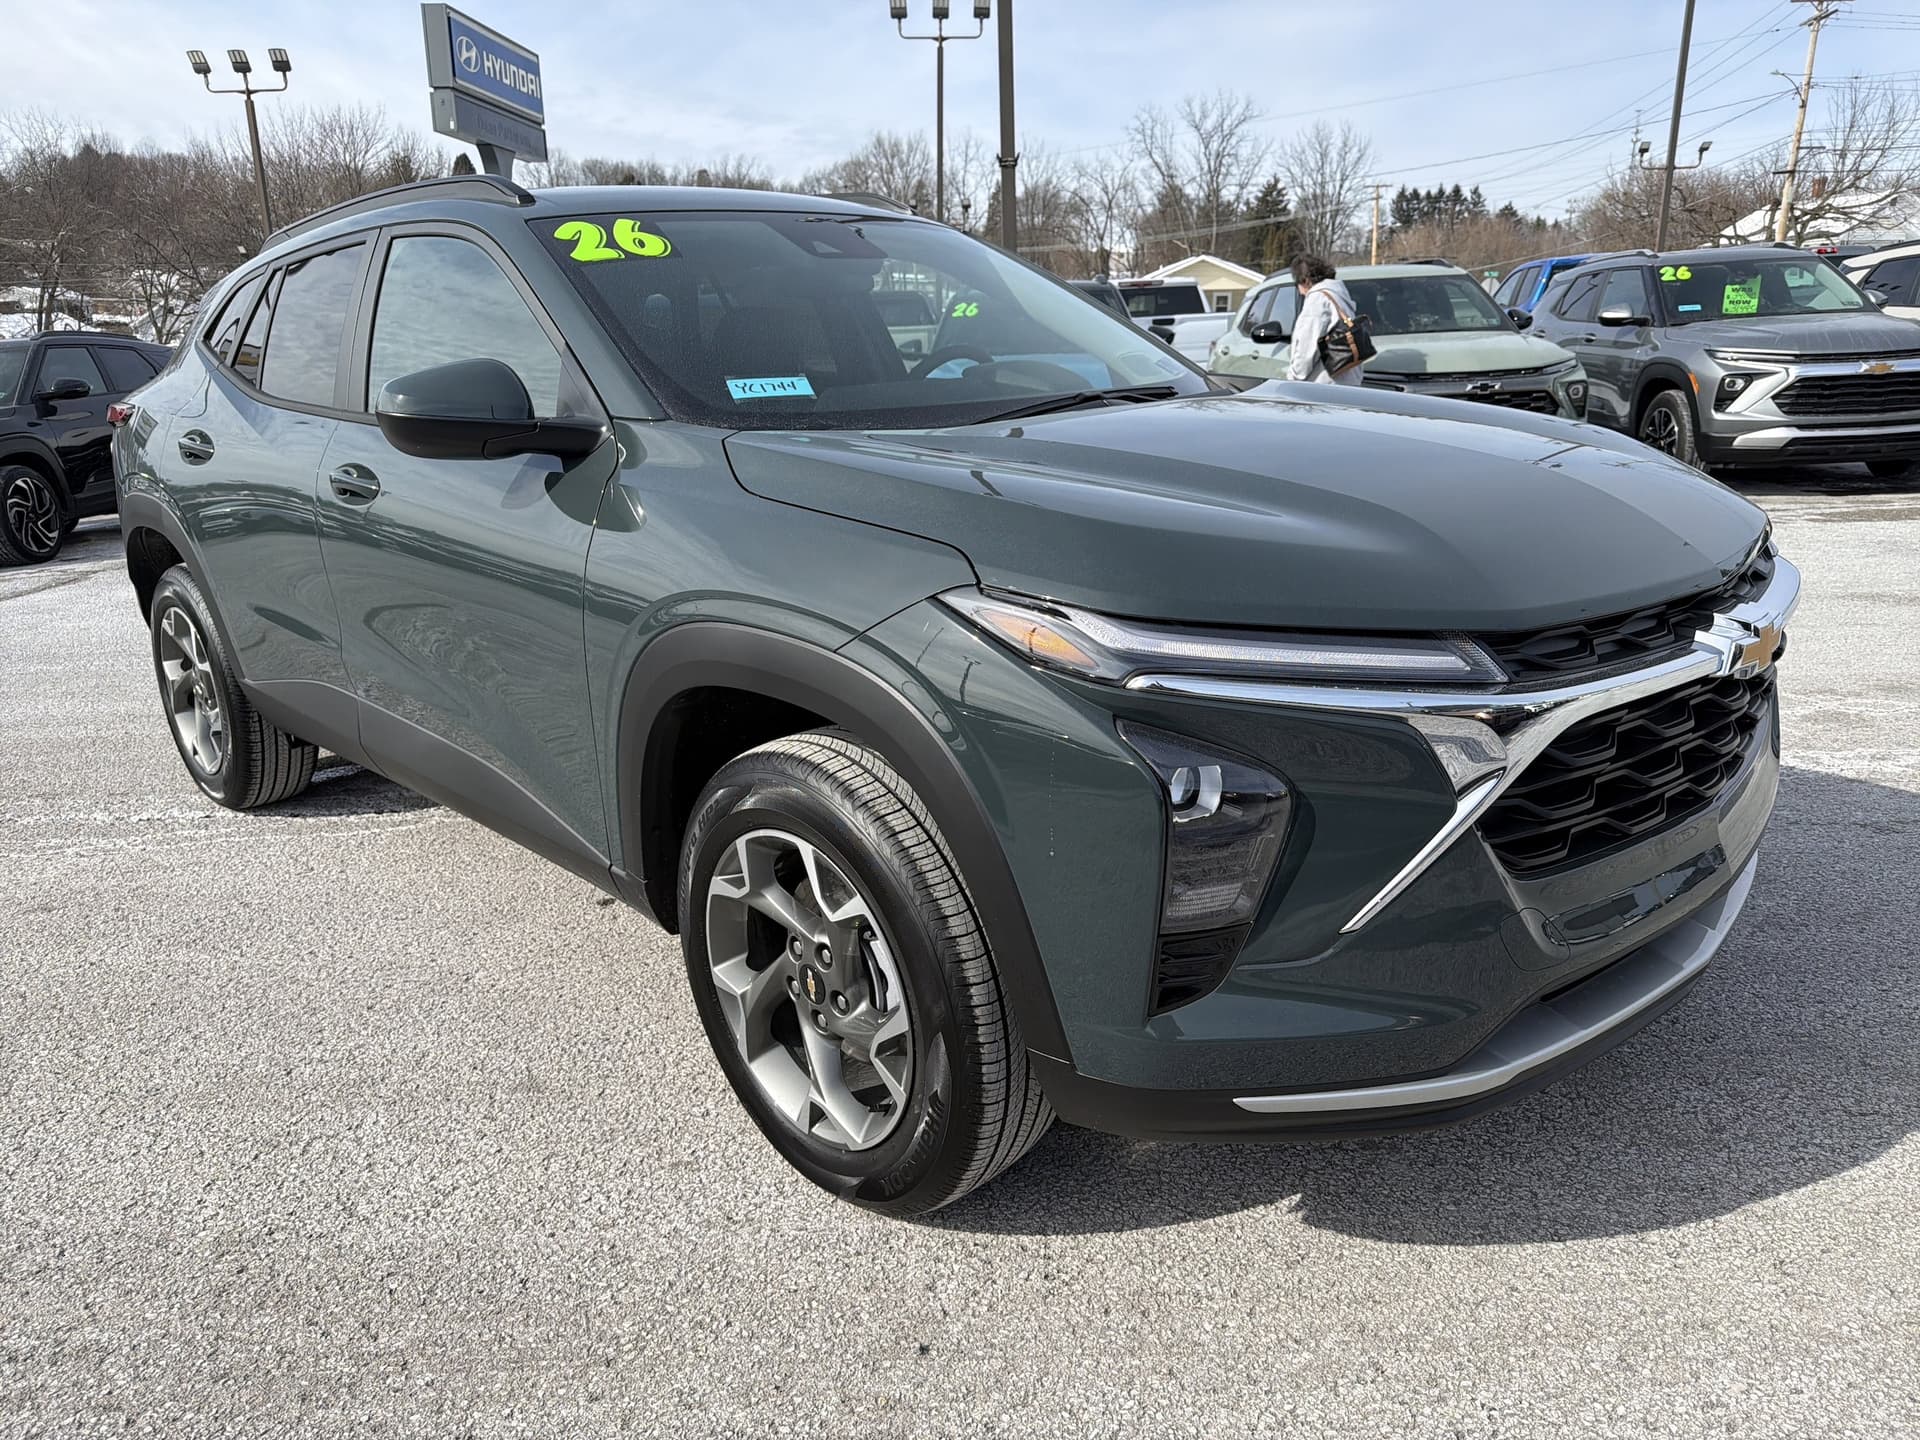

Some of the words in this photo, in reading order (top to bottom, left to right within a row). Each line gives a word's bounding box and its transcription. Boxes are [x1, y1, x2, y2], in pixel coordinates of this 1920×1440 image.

[483, 50, 541, 99] HYUNDAI
[553, 218, 672, 262] 26
[1658, 265, 1692, 282] 26
[951, 302, 979, 318] 26
[734, 380, 798, 395] YC1744
